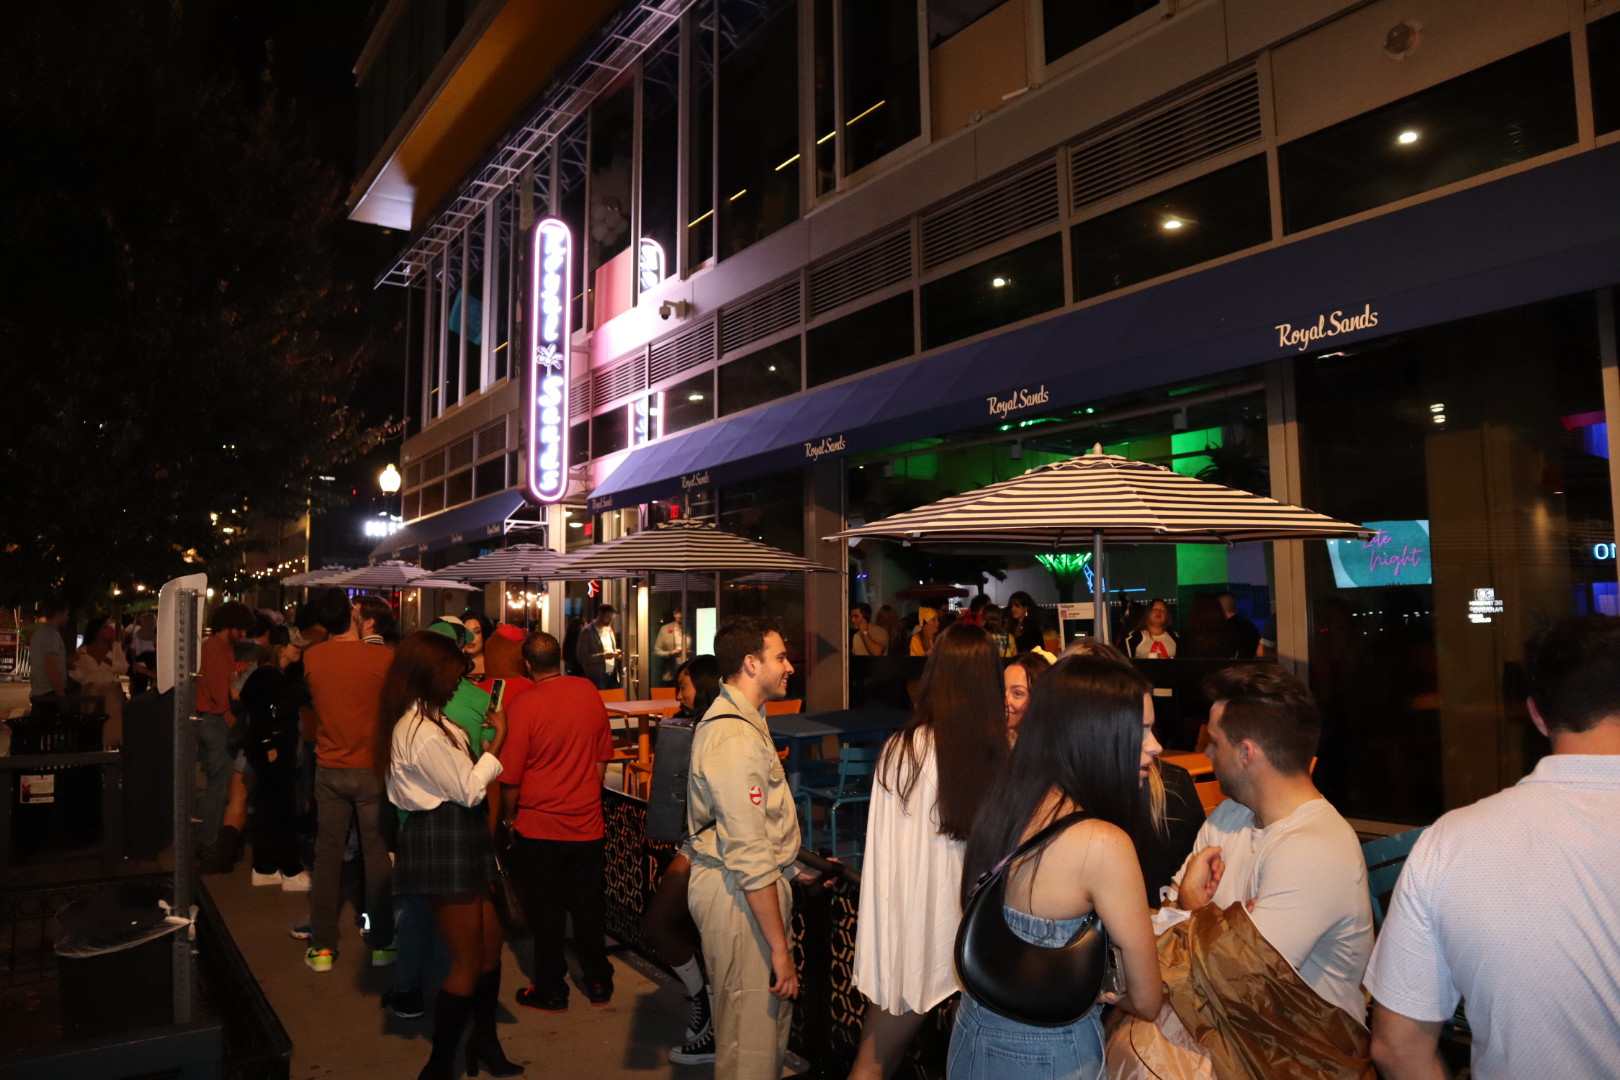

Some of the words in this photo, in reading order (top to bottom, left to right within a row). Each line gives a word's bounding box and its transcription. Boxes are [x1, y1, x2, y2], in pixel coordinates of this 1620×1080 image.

[1274, 314, 1327, 351] Royal
[1327, 303, 1379, 336] Sands
[986, 390, 1019, 419] Royal
[1019, 384, 1049, 408] Sands
[804, 438, 825, 462] Royal
[825, 434, 846, 453] Sands
